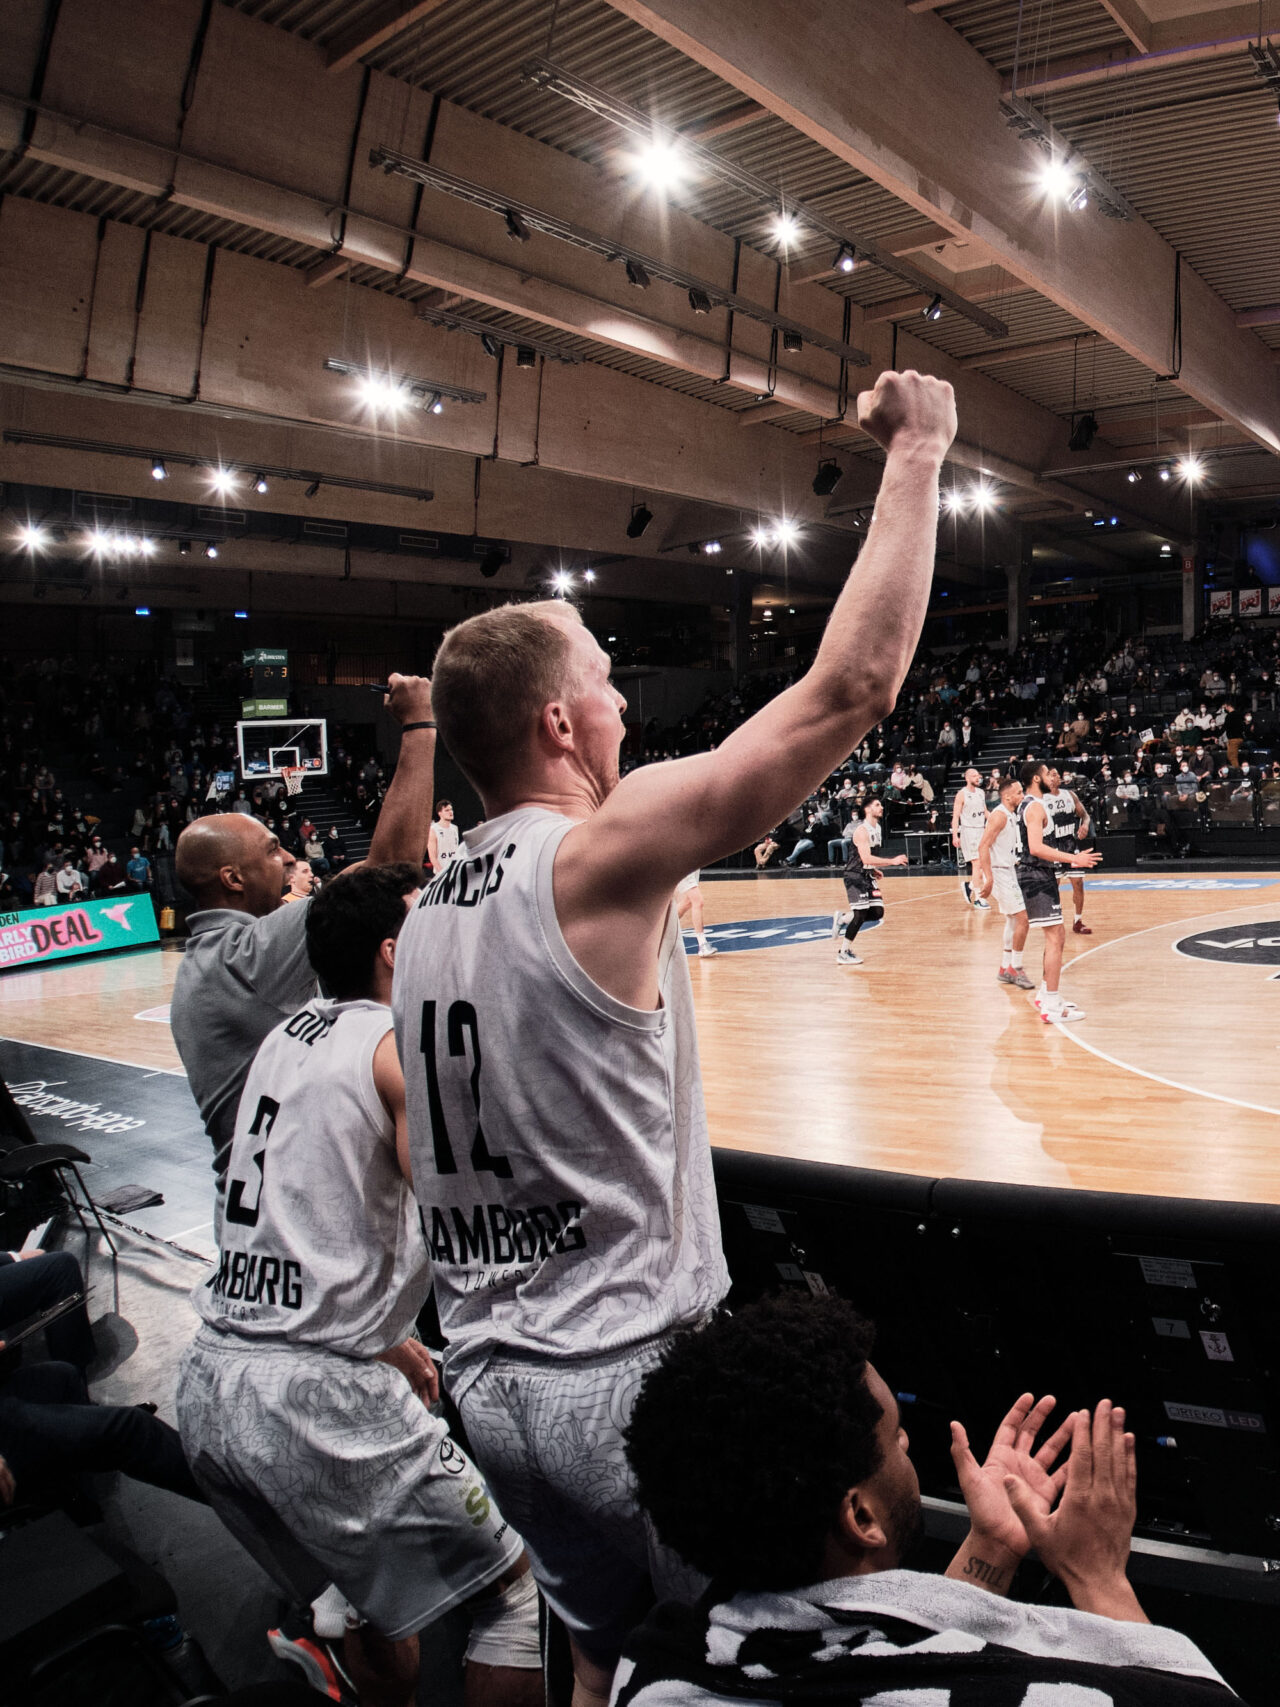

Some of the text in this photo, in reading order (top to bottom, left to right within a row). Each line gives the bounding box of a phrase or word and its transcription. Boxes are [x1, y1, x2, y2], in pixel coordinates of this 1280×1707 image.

[1056, 799, 1066, 809] 23
[31, 913, 98, 952] DEAL
[420, 999, 514, 1178] 12
[226, 1095, 280, 1228] 3
[1166, 1322, 1175, 1334] 7
[1228, 1415, 1261, 1428] LED
[963, 1555, 1005, 1589] STILL
